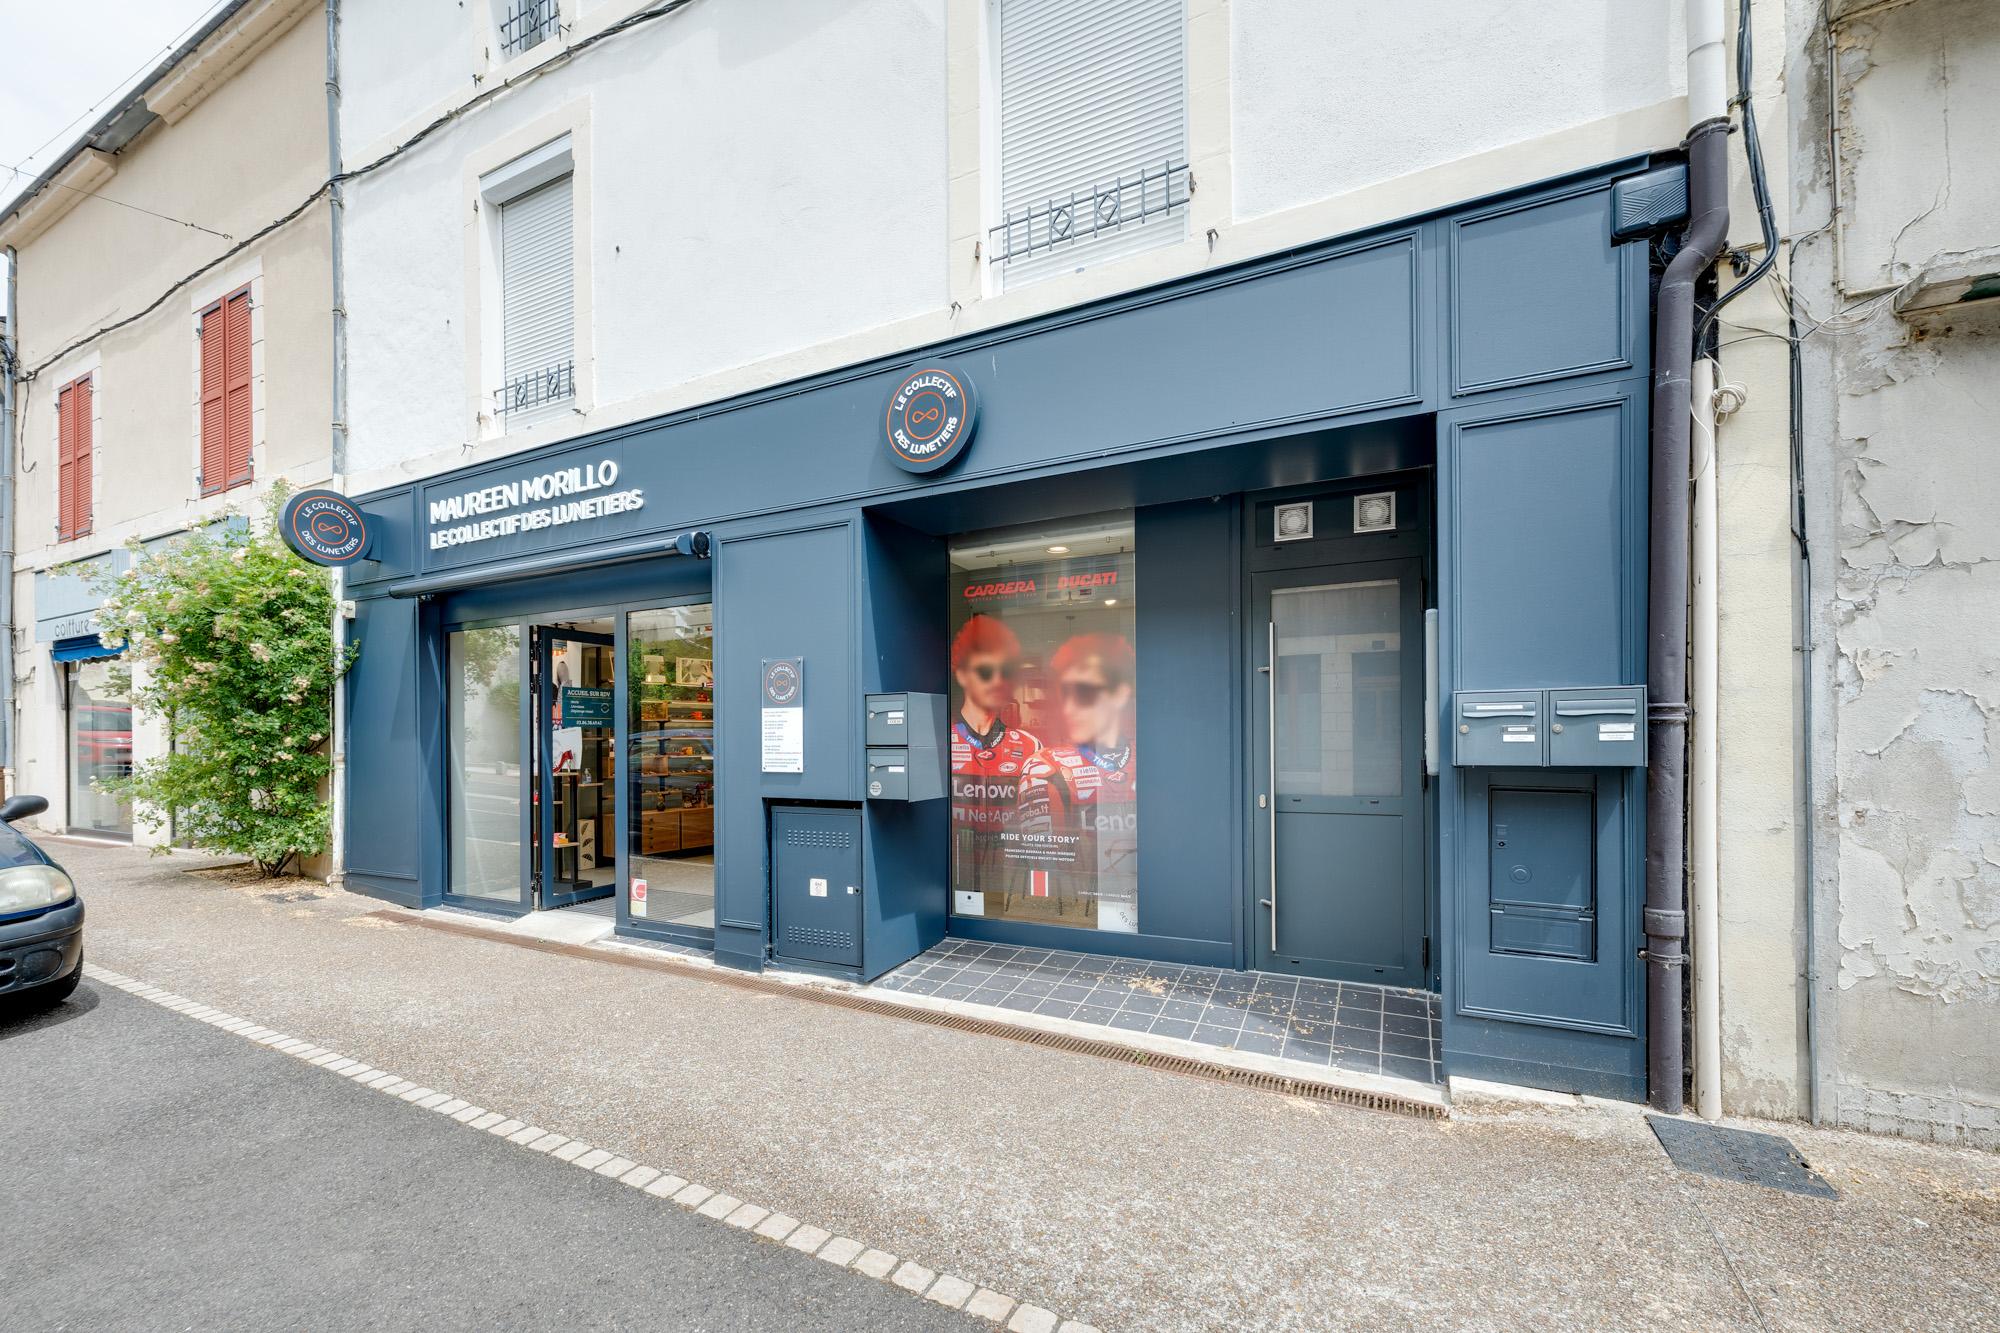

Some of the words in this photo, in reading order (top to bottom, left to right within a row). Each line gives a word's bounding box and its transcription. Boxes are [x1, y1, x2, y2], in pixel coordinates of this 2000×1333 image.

[894, 394, 908, 411] LE
[905, 375, 957, 398] COLLECTIF
[894, 428, 911, 450] DES
[909, 416, 958, 454] LUNETIERS
[430, 482, 519, 525] MAUREEN
[521, 459, 618, 504] MORILLO
[301, 506, 313, 518] LE
[311, 501, 358, 526] COLLECTIF
[430, 530, 449, 550] LE
[448, 514, 522, 546] COLLECTIF
[520, 508, 552, 532] DES
[552, 488, 645, 526] LUNETIERS
[301, 530, 316, 546] DES
[316, 536, 359, 555] LUNETIERS
[963, 578, 1037, 599] CARRERA
[1057, 571, 1118, 591] DUCATI
[1093, 755, 1109, 767] TIM
[1000, 832, 1020, 841] RIDE
[1022, 833, 1045, 842] YOUR
